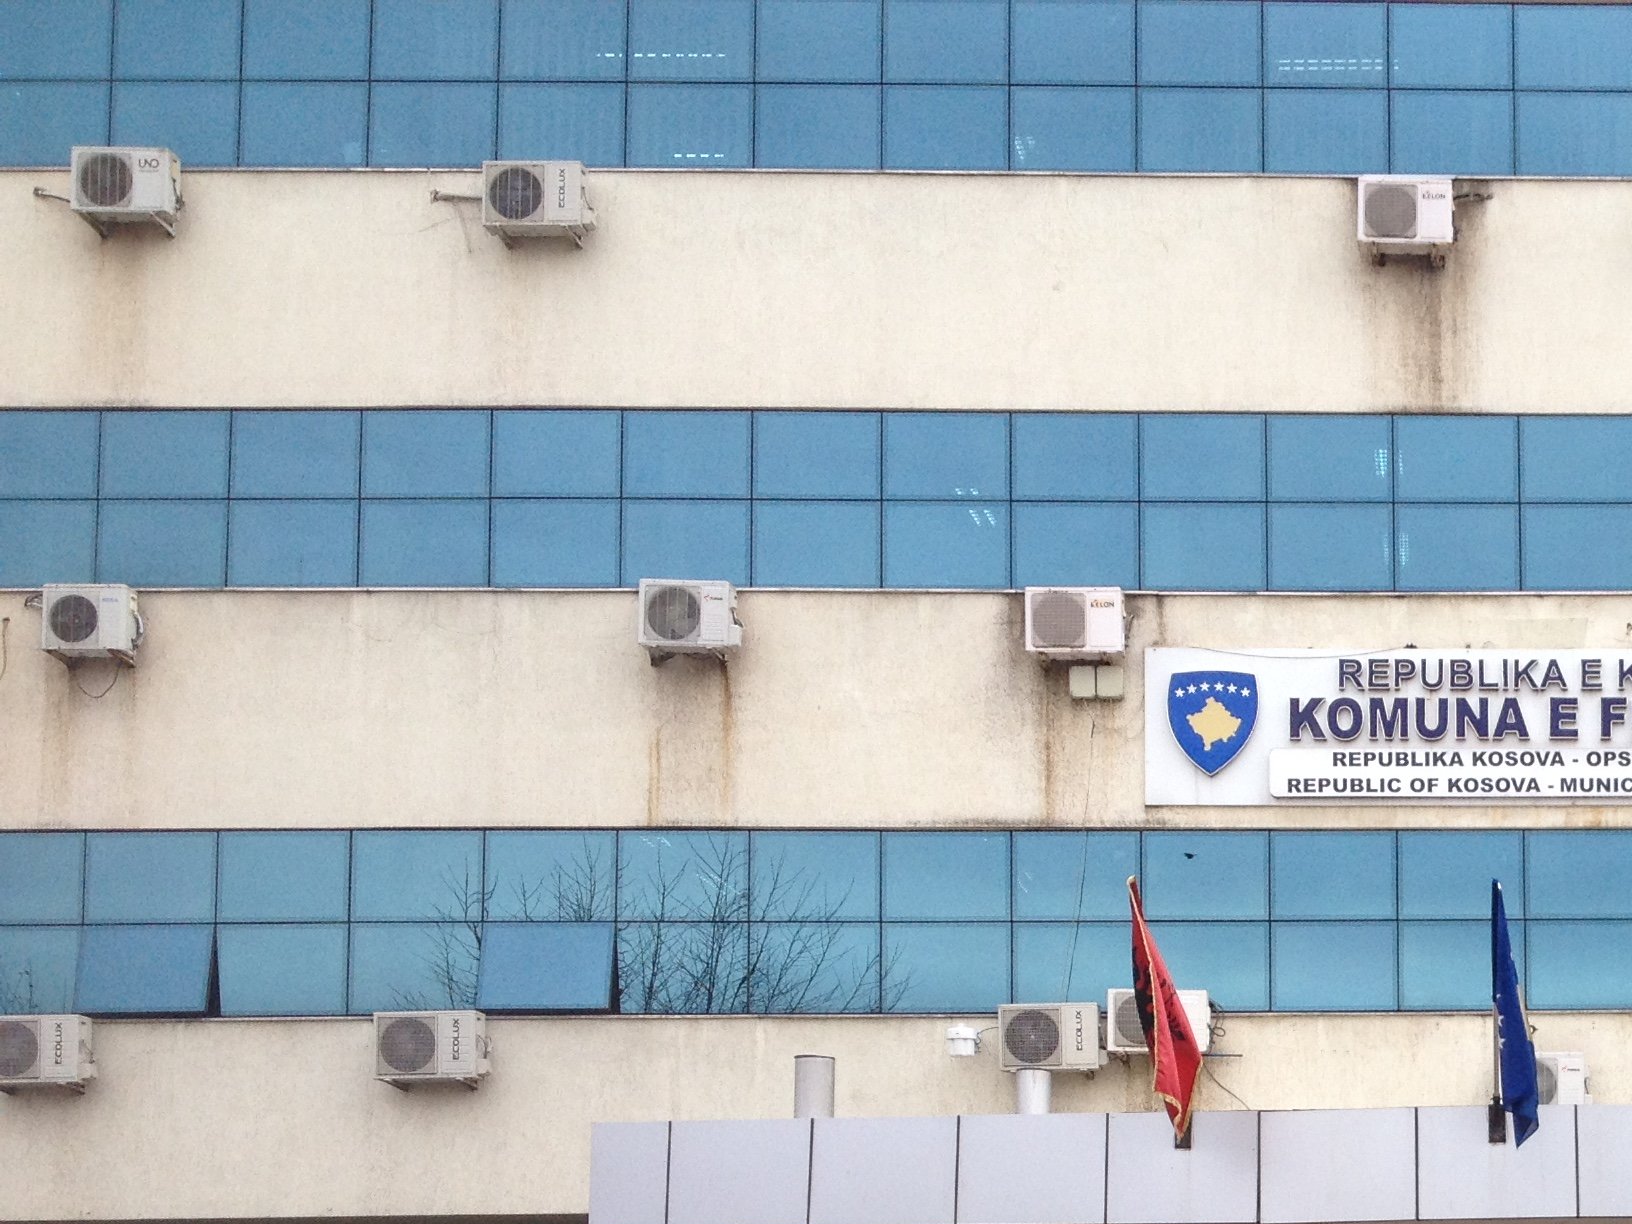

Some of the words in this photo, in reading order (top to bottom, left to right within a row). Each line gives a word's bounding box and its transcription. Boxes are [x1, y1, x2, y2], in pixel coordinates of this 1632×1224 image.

[138, 158, 160, 169] UNO
[558, 168, 566, 209] ECOLUX
[1090, 599, 1115, 608] KELON
[1338, 658, 1568, 691] REPUBLIKA
[1580, 658, 1602, 691] E
[1289, 697, 1530, 741] KOMUNA
[1549, 697, 1579, 741] E
[1332, 751, 1464, 767] REPUBLIKA
[1472, 751, 1565, 767] KOSOVA
[1287, 777, 1402, 794] REPUBLIC
[1410, 777, 1439, 793] OF
[1448, 777, 1541, 793] KOSOVA
[55, 1022, 63, 1066] ECOLUX
[1075, 1010, 1083, 1051] ECOLUX
